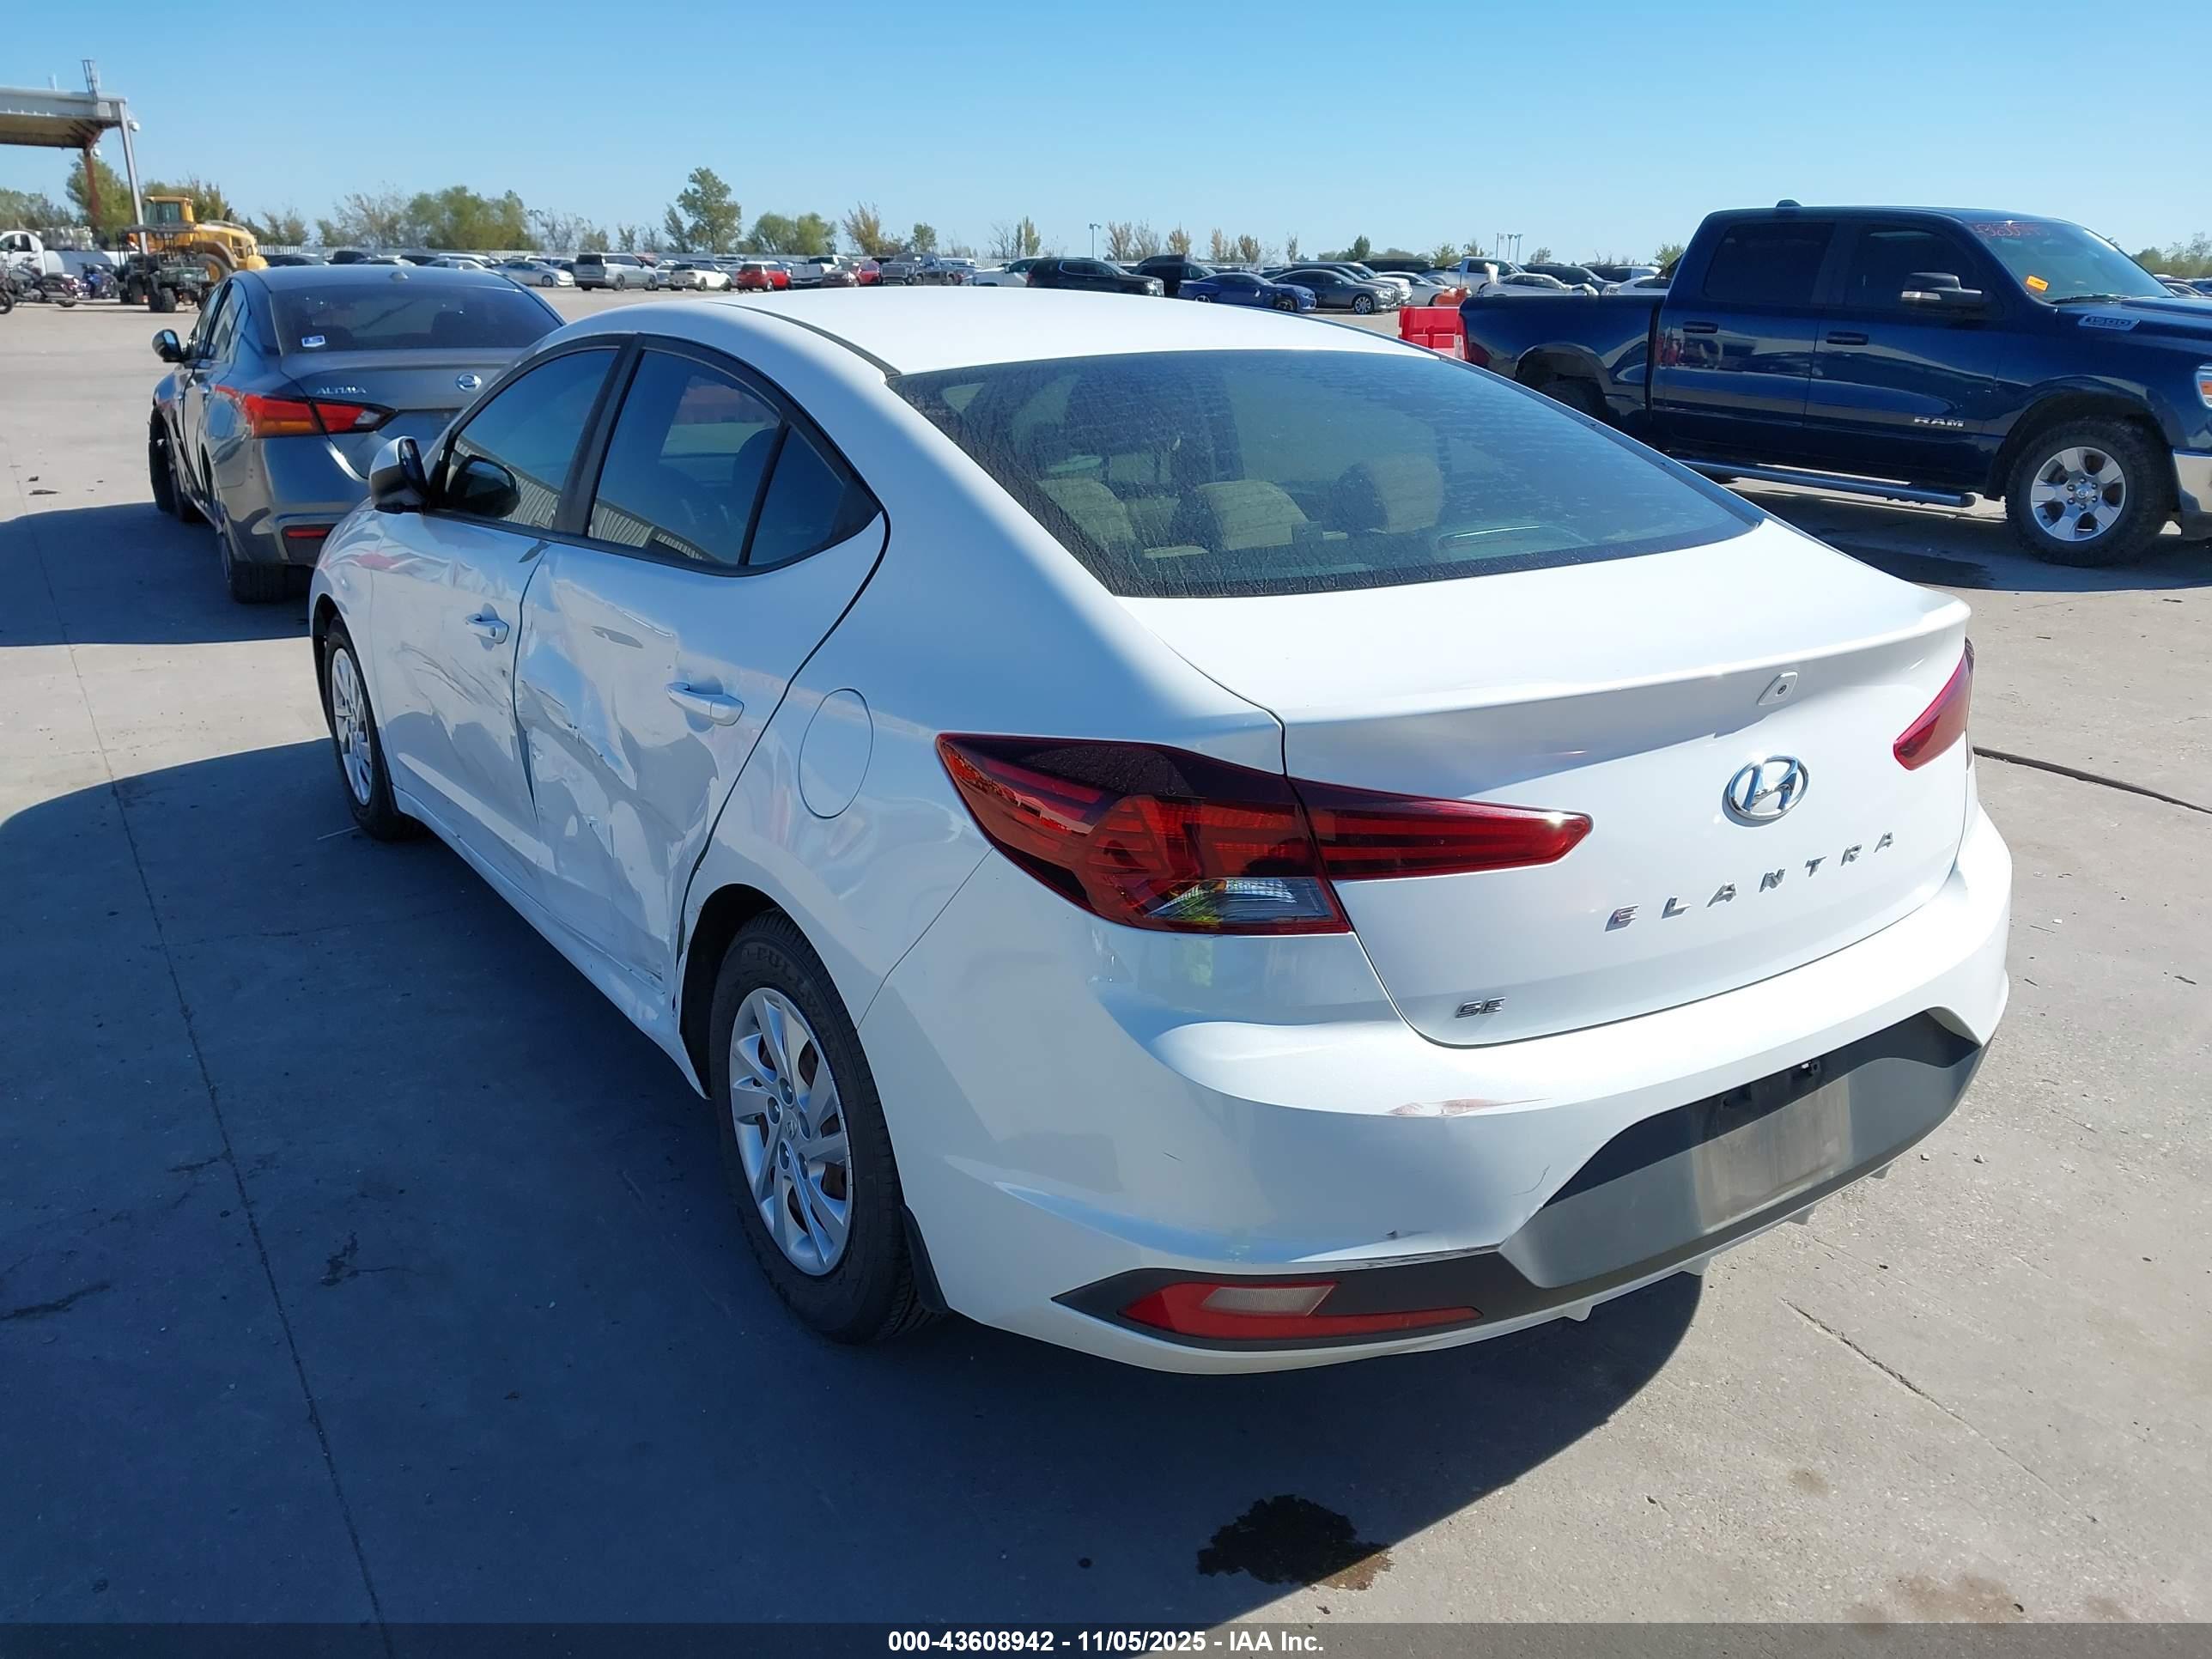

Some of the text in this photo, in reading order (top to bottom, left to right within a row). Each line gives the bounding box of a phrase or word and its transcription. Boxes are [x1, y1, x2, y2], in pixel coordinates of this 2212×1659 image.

[316, 385, 368, 395] ALTIMA
[1914, 416, 1966, 428] RAM
[1604, 830, 1894, 933] ELANTRA
[1455, 996, 1506, 1018] SE
